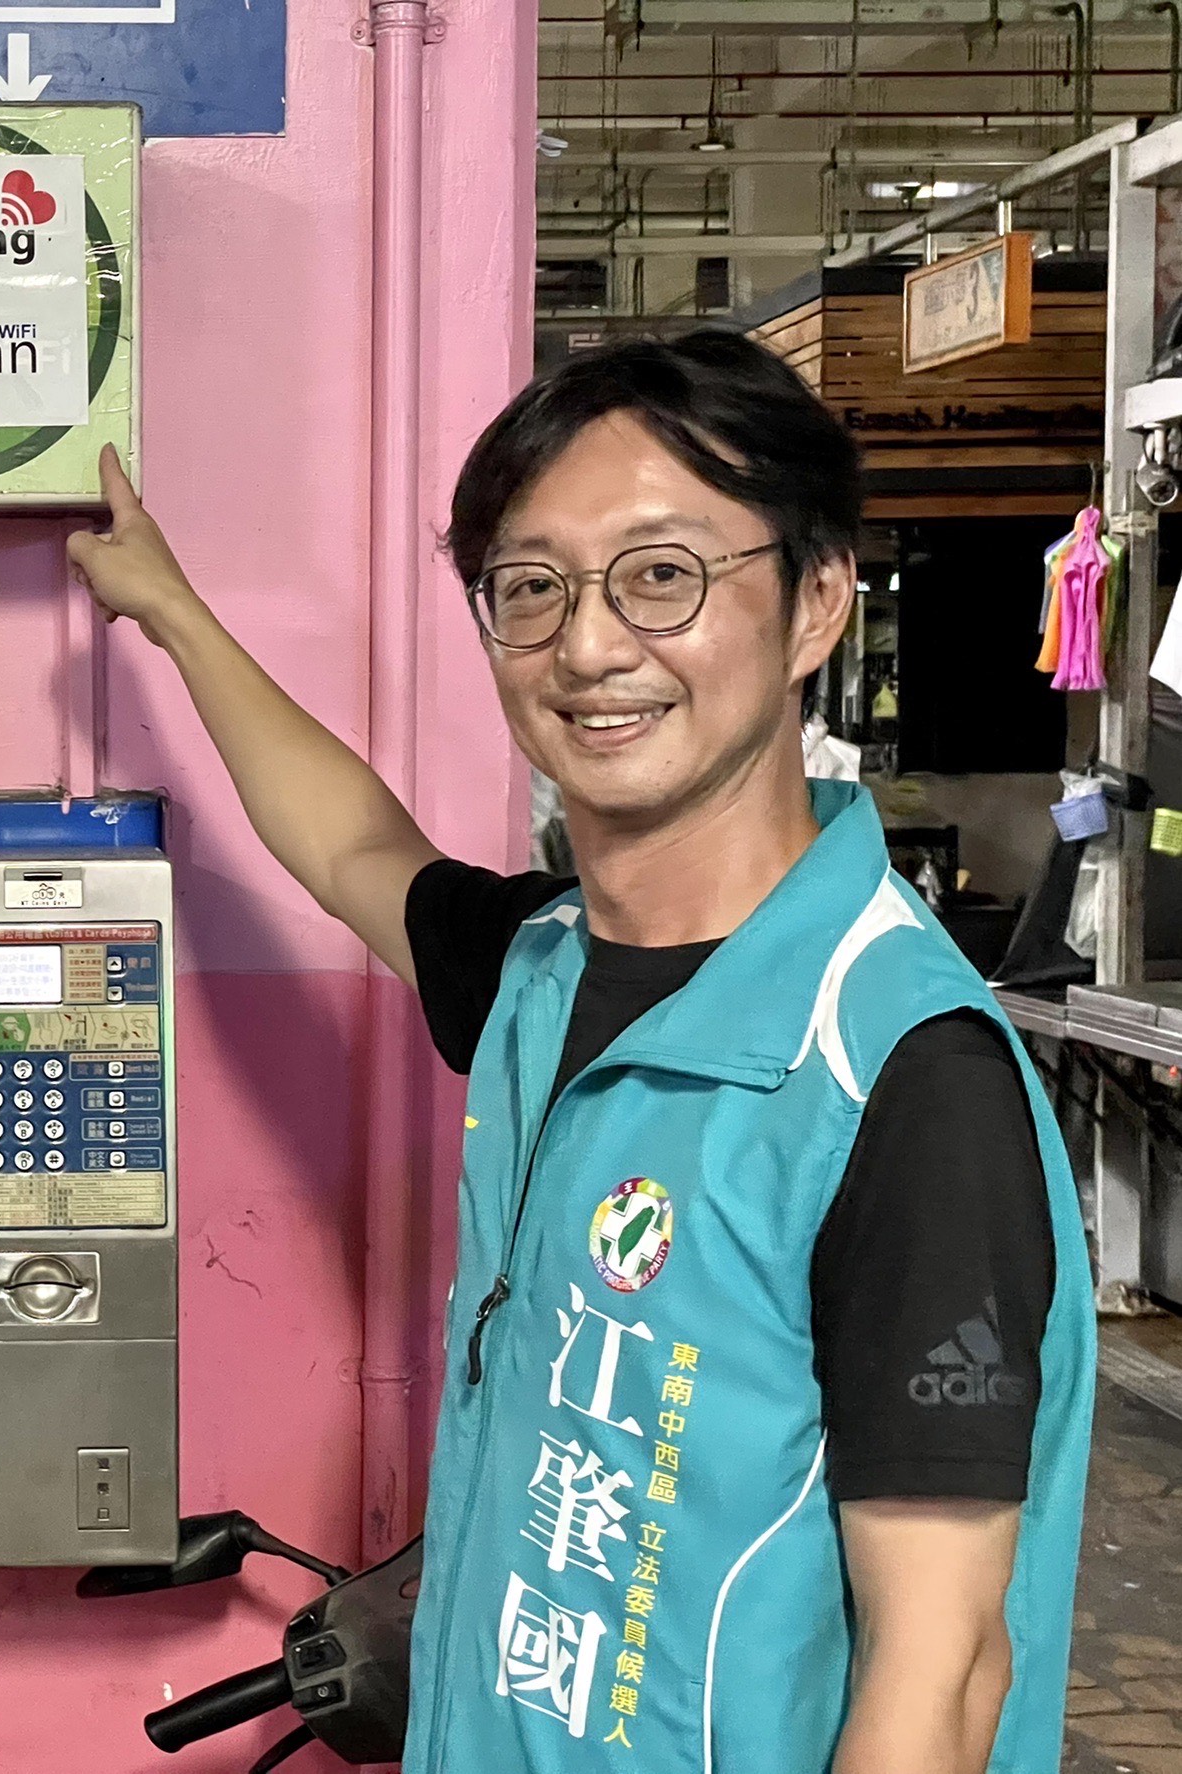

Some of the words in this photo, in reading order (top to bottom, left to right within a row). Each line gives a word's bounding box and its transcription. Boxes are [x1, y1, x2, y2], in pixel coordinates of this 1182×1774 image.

[649, 1245, 669, 1277] PARTY
[495, 1282, 656, 1739] 江肇國
[645, 1341, 701, 1505] 東南中西區
[603, 1520, 668, 1750] 立法委員候選人
